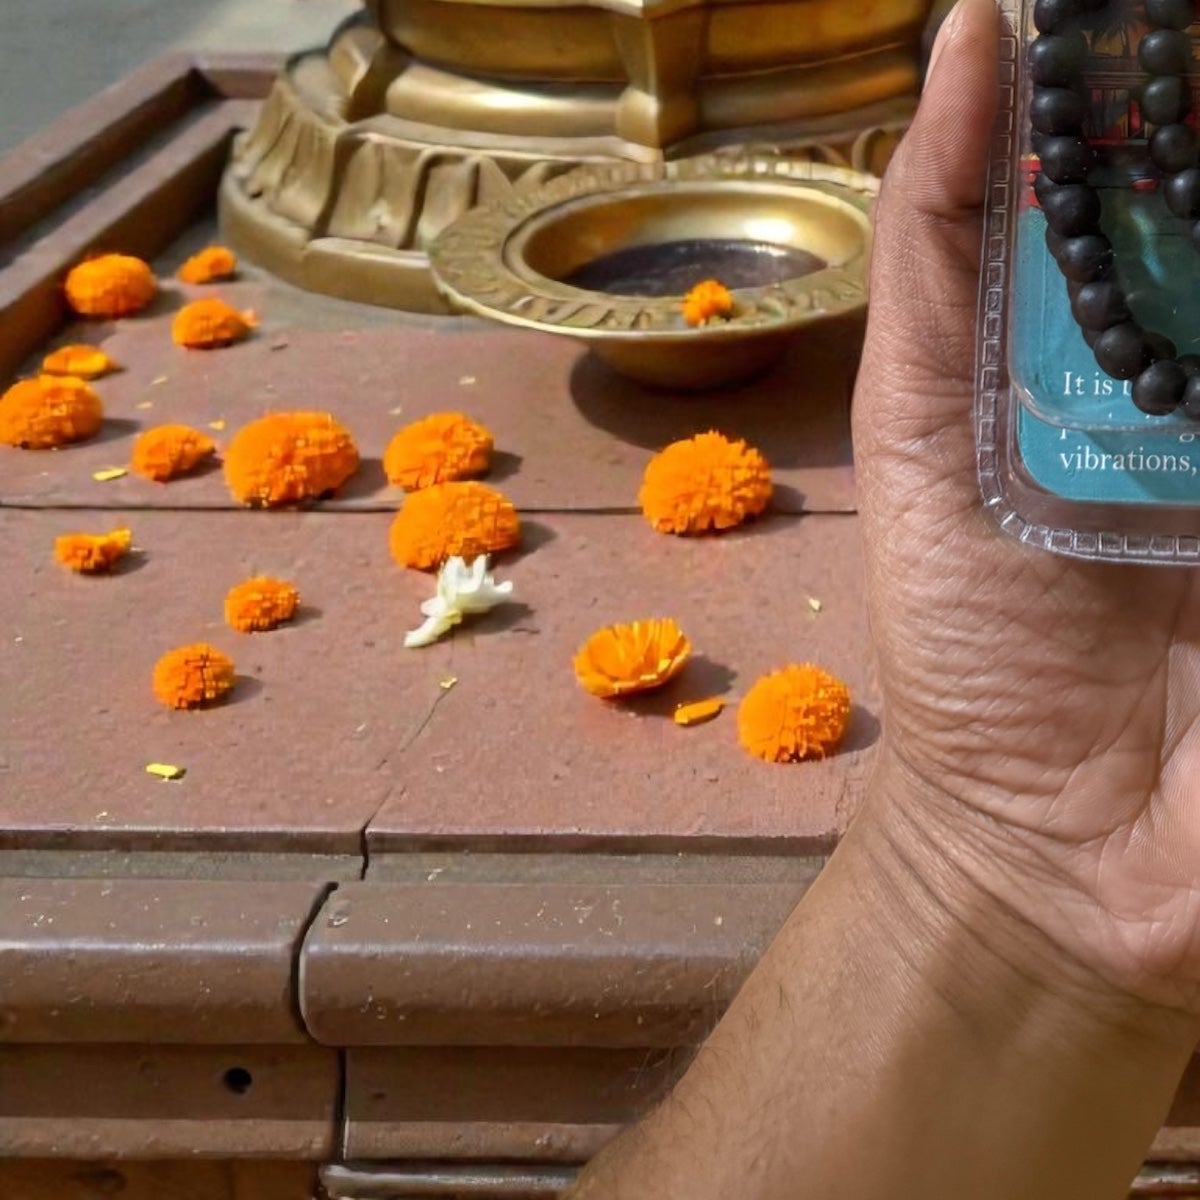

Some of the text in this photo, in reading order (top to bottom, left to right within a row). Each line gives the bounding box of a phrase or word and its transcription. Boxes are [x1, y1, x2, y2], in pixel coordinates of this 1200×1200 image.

[1064, 371, 1085, 395] It
[1093, 371, 1113, 395] is
[1060, 445, 1198, 475] vibrations,
